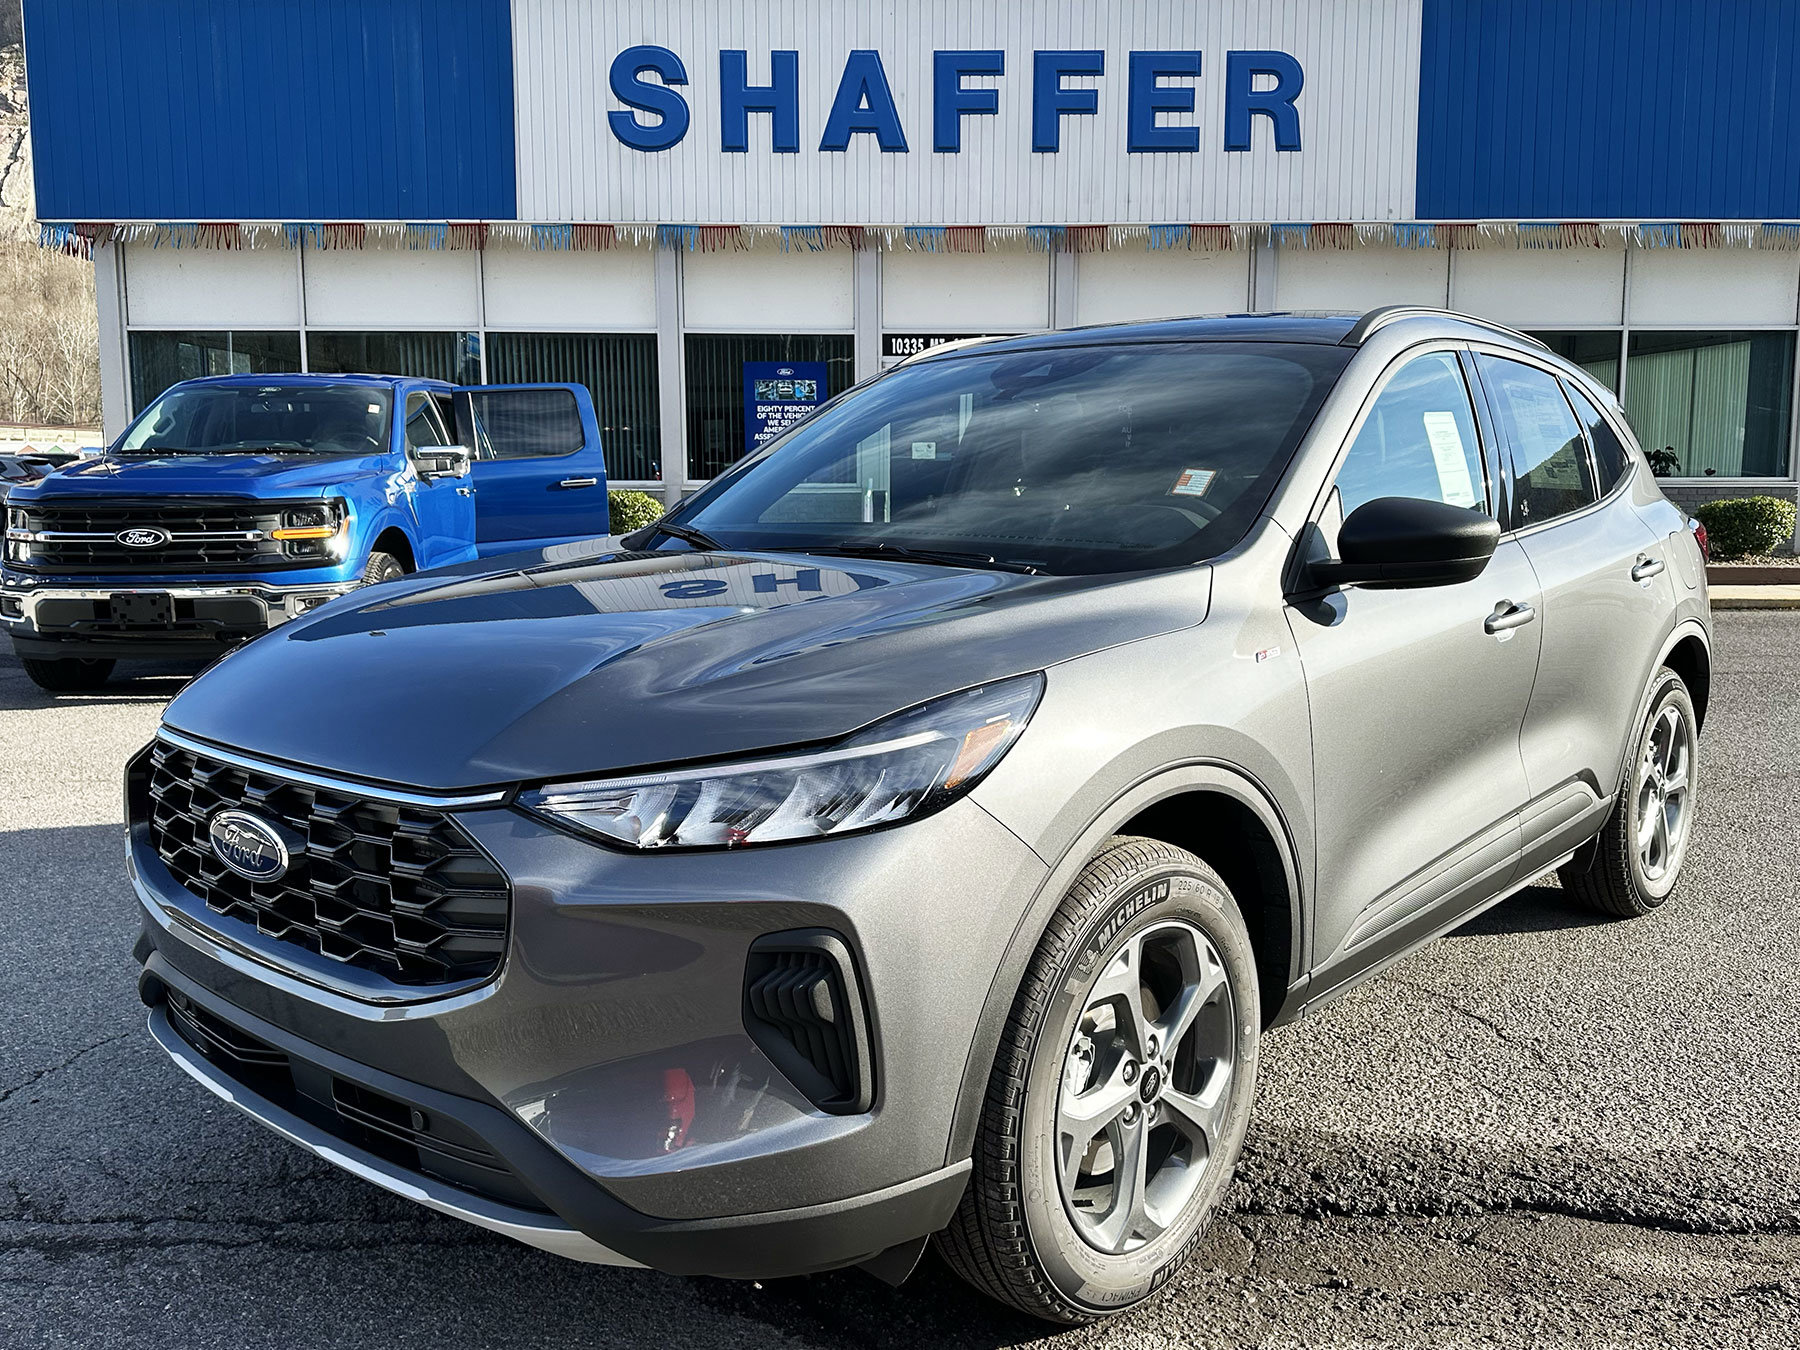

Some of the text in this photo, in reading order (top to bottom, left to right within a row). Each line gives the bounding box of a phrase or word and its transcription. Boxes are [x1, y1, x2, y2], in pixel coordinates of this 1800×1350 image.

[607, 45, 1304, 153] SHAFFER
[891, 337, 924, 354] 10335
[124, 530, 157, 545] Ford
[219, 822, 270, 868] Ford
[1098, 882, 1168, 948] MICHELIN
